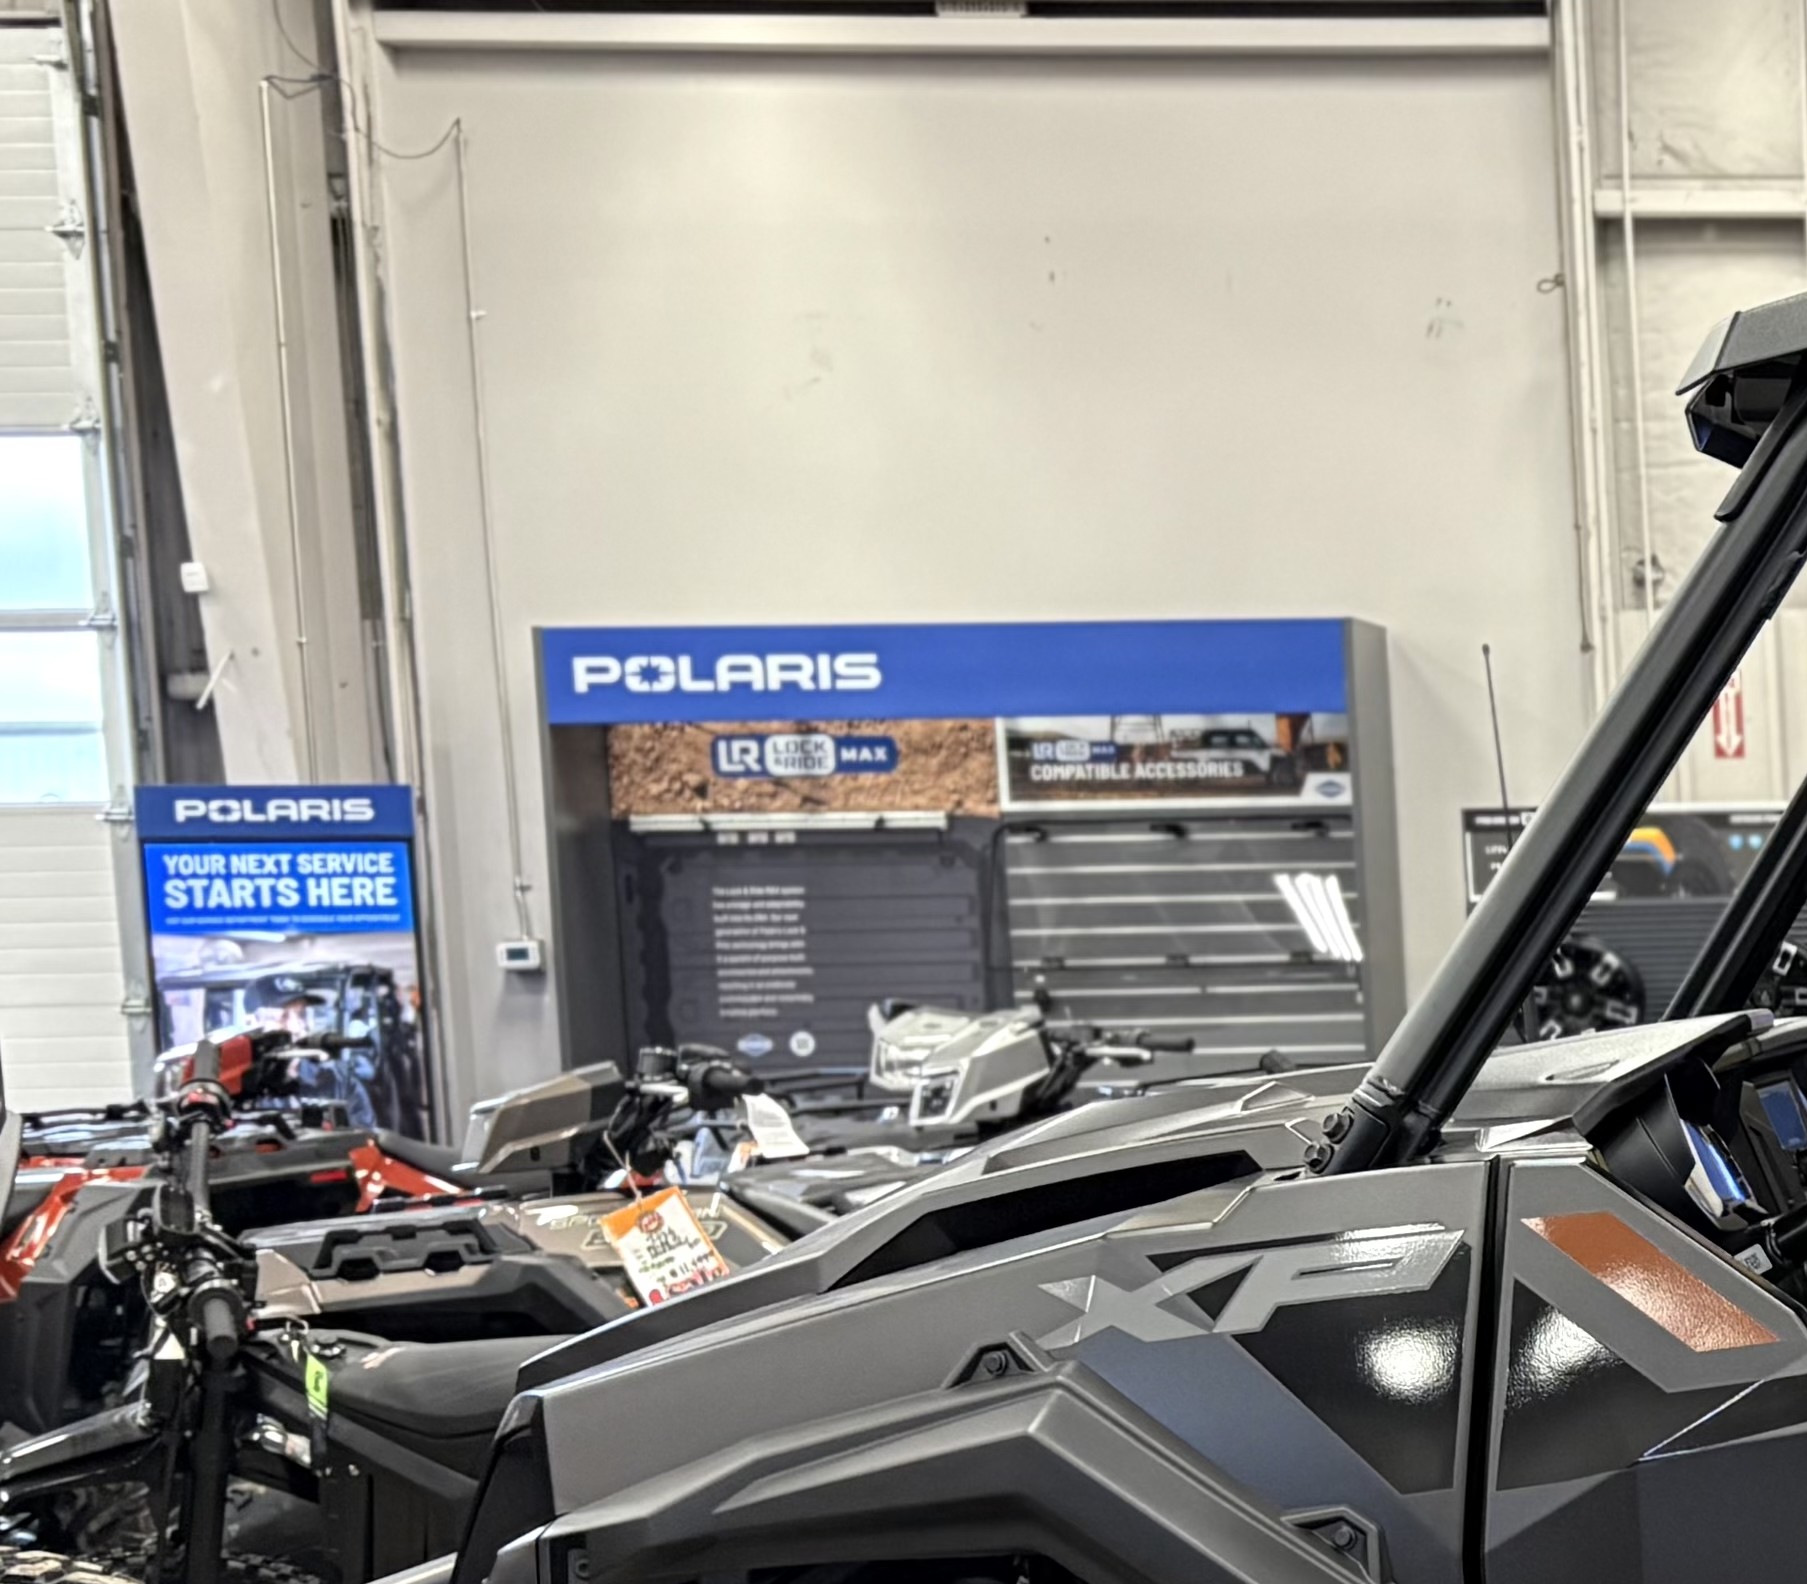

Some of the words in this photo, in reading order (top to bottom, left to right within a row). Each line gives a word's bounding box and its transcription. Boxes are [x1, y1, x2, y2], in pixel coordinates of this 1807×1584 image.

[572, 653, 882, 693] POLARIS
[772, 739, 826, 755] LOCK
[841, 746, 888, 763] MAX
[1030, 763, 1130, 781] COMPATIBLE
[1134, 762, 1243, 780] ACCESSORIES
[174, 798, 375, 823] POLARIS
[163, 853, 226, 876] YOUR
[230, 853, 293, 875] NEXT
[296, 852, 395, 874] SERVICE
[163, 877, 301, 909] STARTS
[306, 876, 399, 907] HERE
[1034, 1221, 1466, 1351] XP
